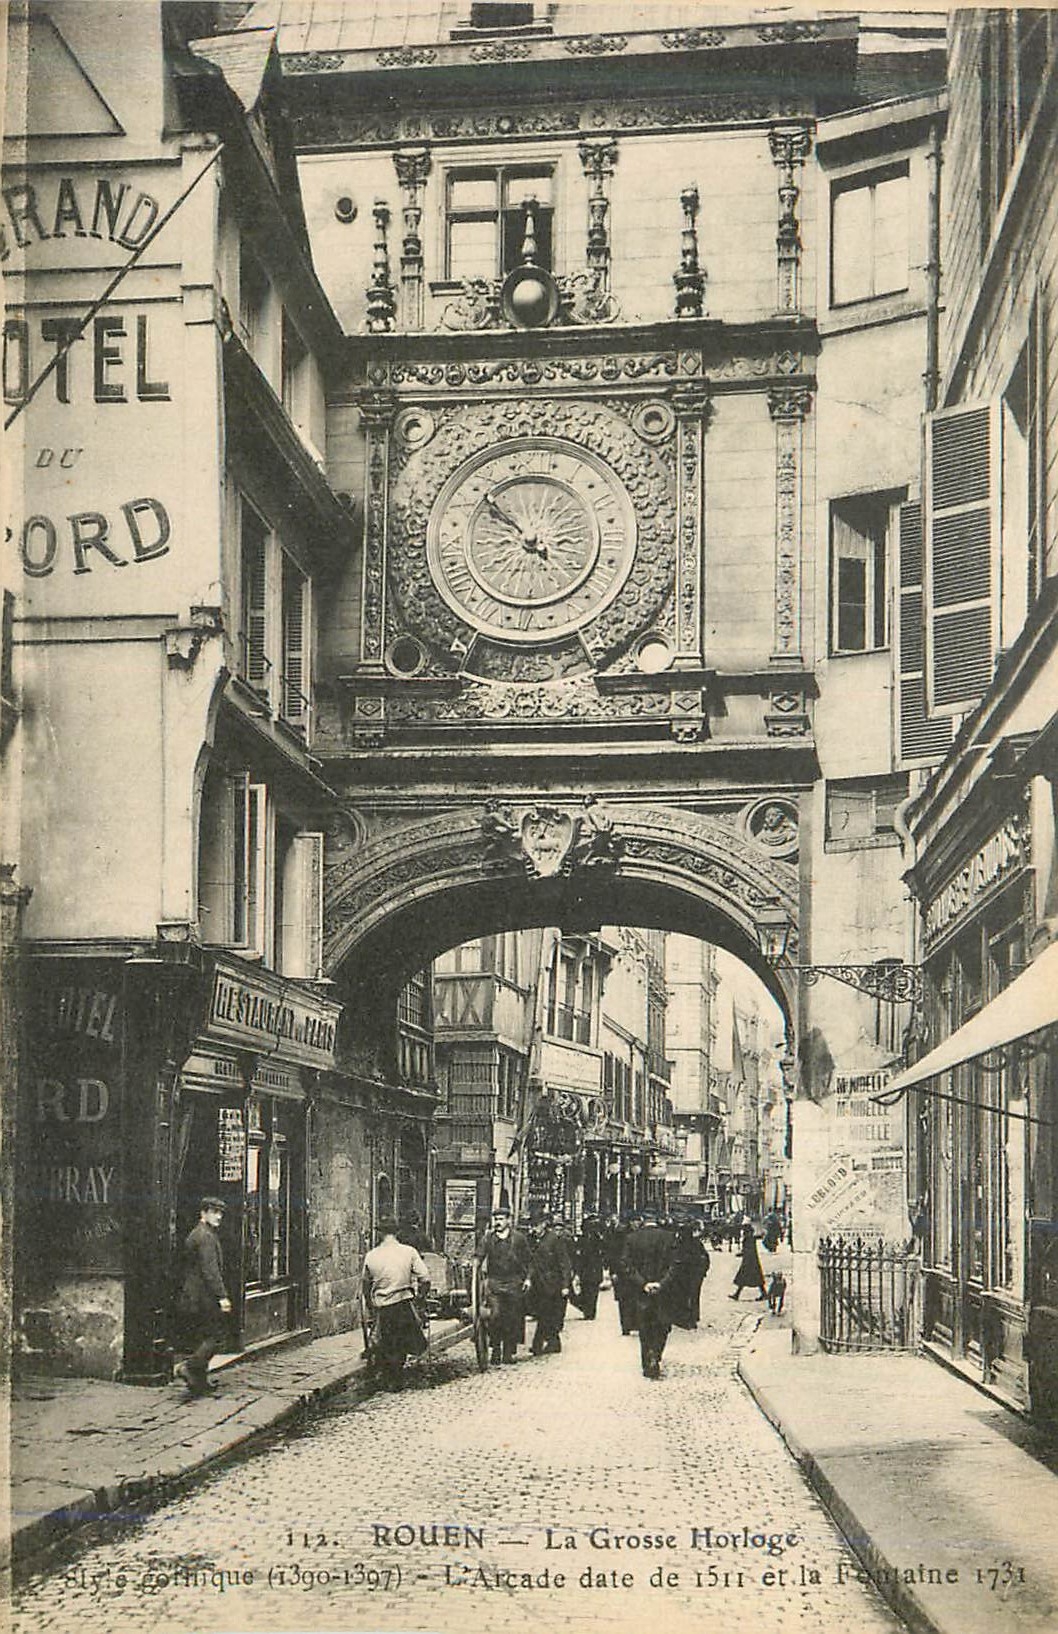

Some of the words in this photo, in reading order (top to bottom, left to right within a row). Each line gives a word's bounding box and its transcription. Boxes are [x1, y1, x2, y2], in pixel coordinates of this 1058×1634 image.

[0, 178, 158, 262] RAND
[35, 447, 83, 468] DU
[5, 497, 170, 577] ORD
